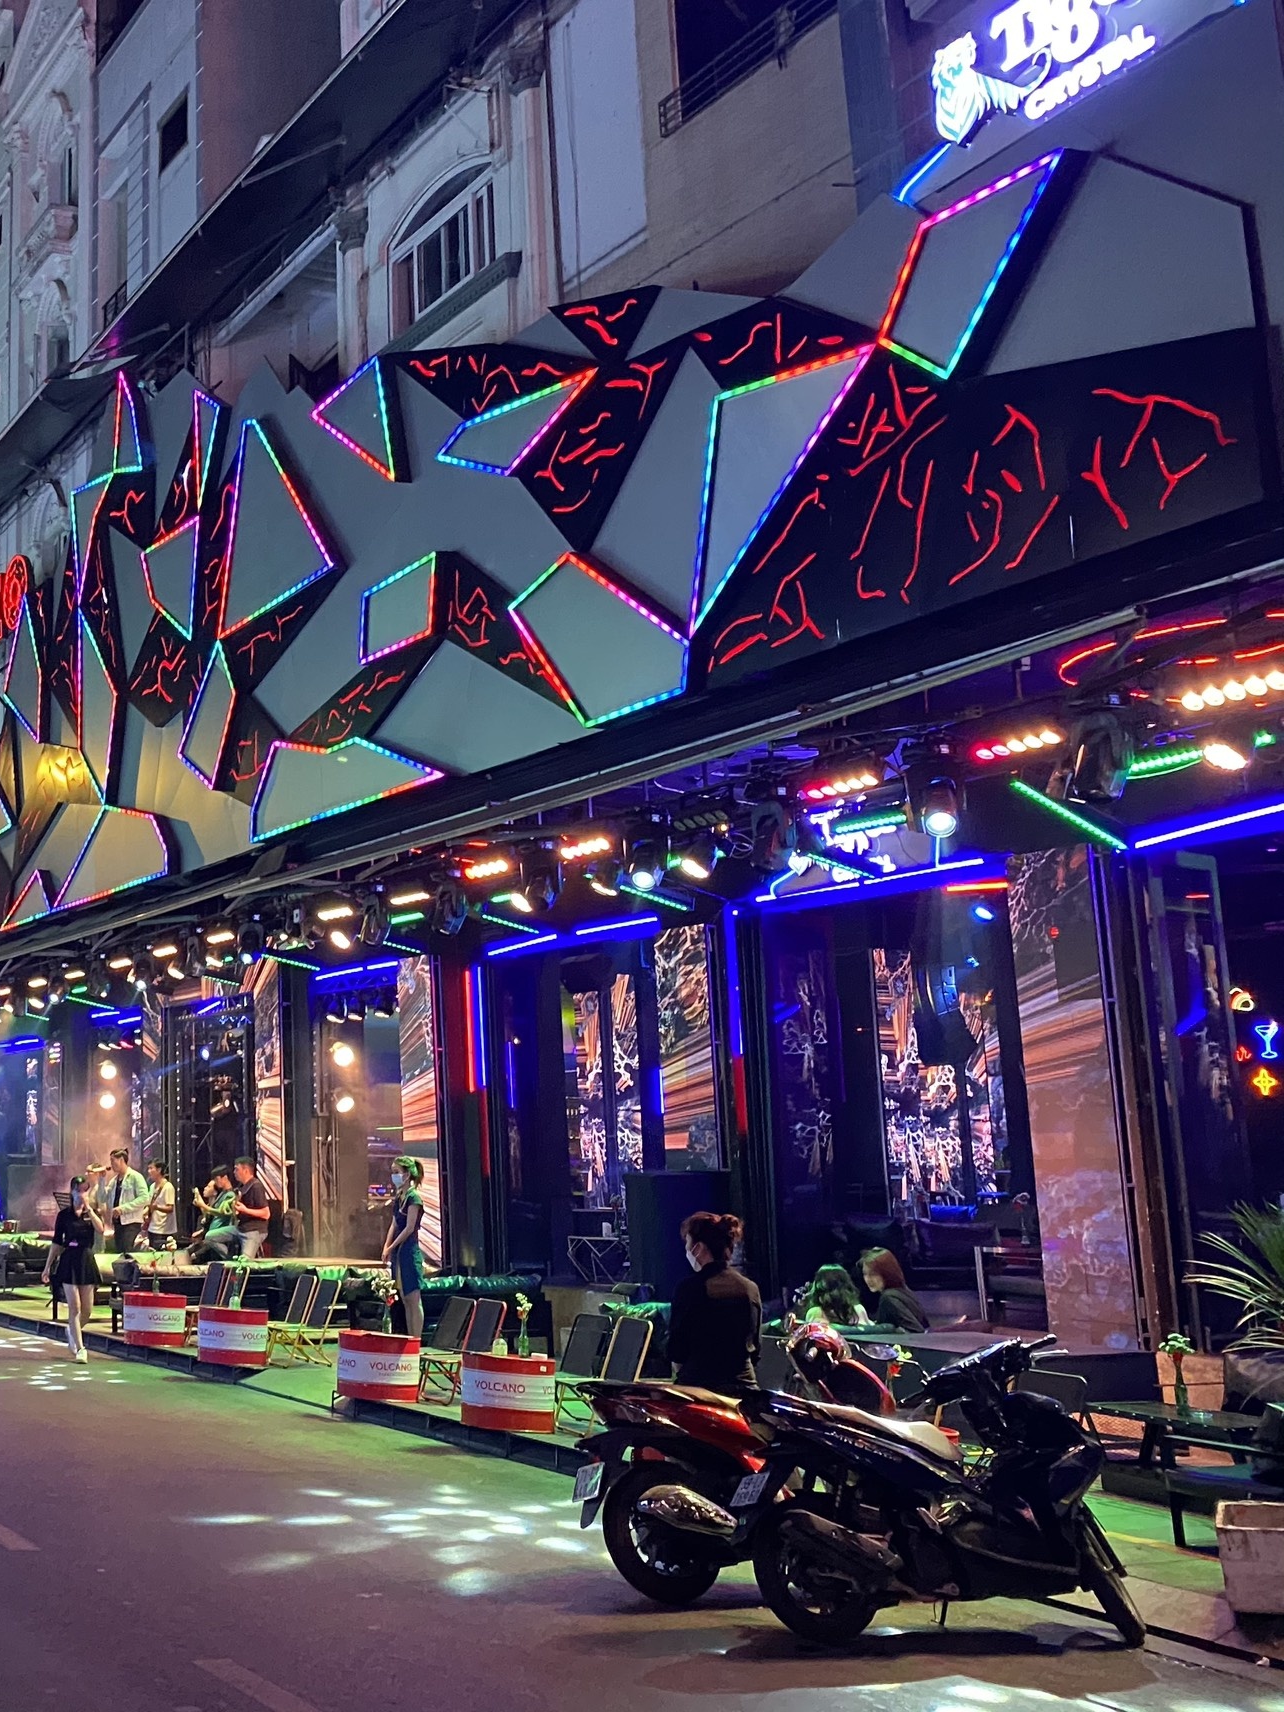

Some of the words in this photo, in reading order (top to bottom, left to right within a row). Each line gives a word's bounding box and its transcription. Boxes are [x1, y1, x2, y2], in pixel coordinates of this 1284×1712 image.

[1024, 24, 1156, 120] CRYSTAL
[147, 1313, 181, 1322] VOLCANO
[370, 1361, 413, 1371] VOLCANO
[475, 1380, 526, 1393] VOLCANO
